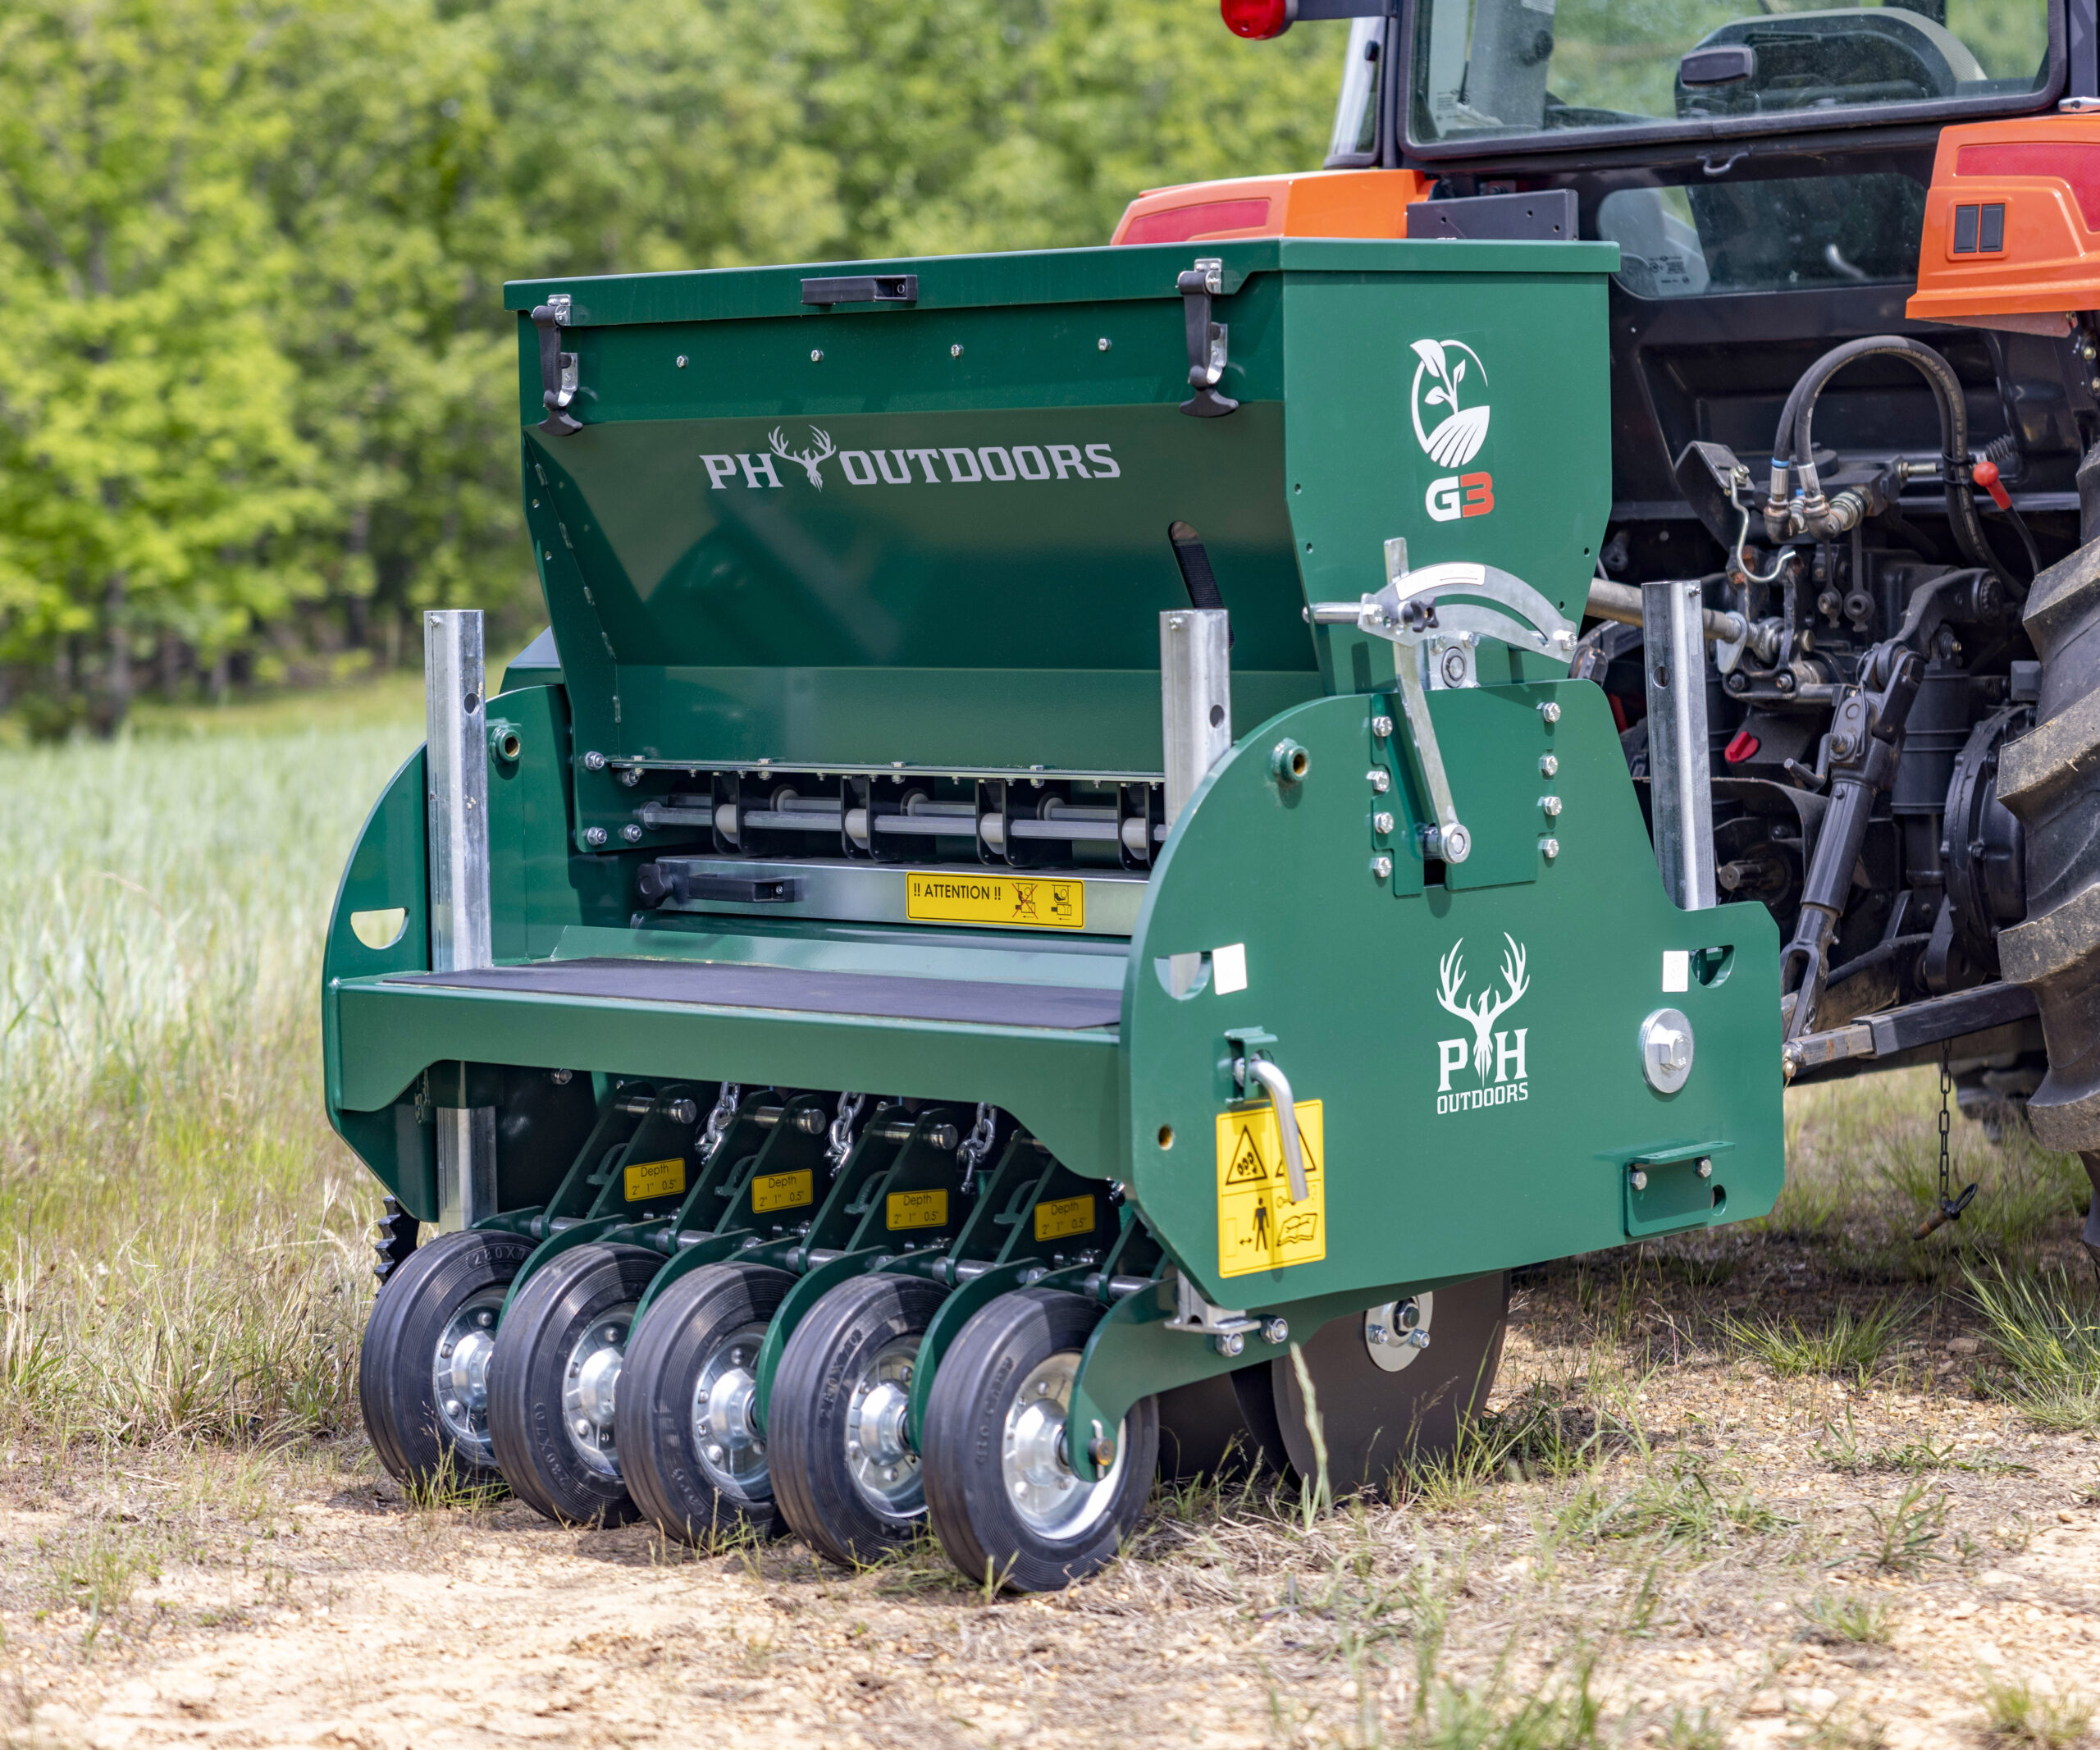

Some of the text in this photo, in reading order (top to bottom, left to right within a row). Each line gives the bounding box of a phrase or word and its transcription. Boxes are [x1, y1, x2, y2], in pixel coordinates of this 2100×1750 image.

[699, 443, 1121, 490] PH OUTDOORS
[1425, 471, 1495, 523] G3
[924, 884, 990, 901] ATTENTION
[1436, 1081, 1529, 1115] OUTDOORS
[641, 1163, 669, 1178] Depth
[769, 1175, 797, 1190] Depth
[903, 1193, 932, 1208] Depth
[1051, 1201, 1080, 1218] Depth
[472, 1246, 527, 1265] 280X7
